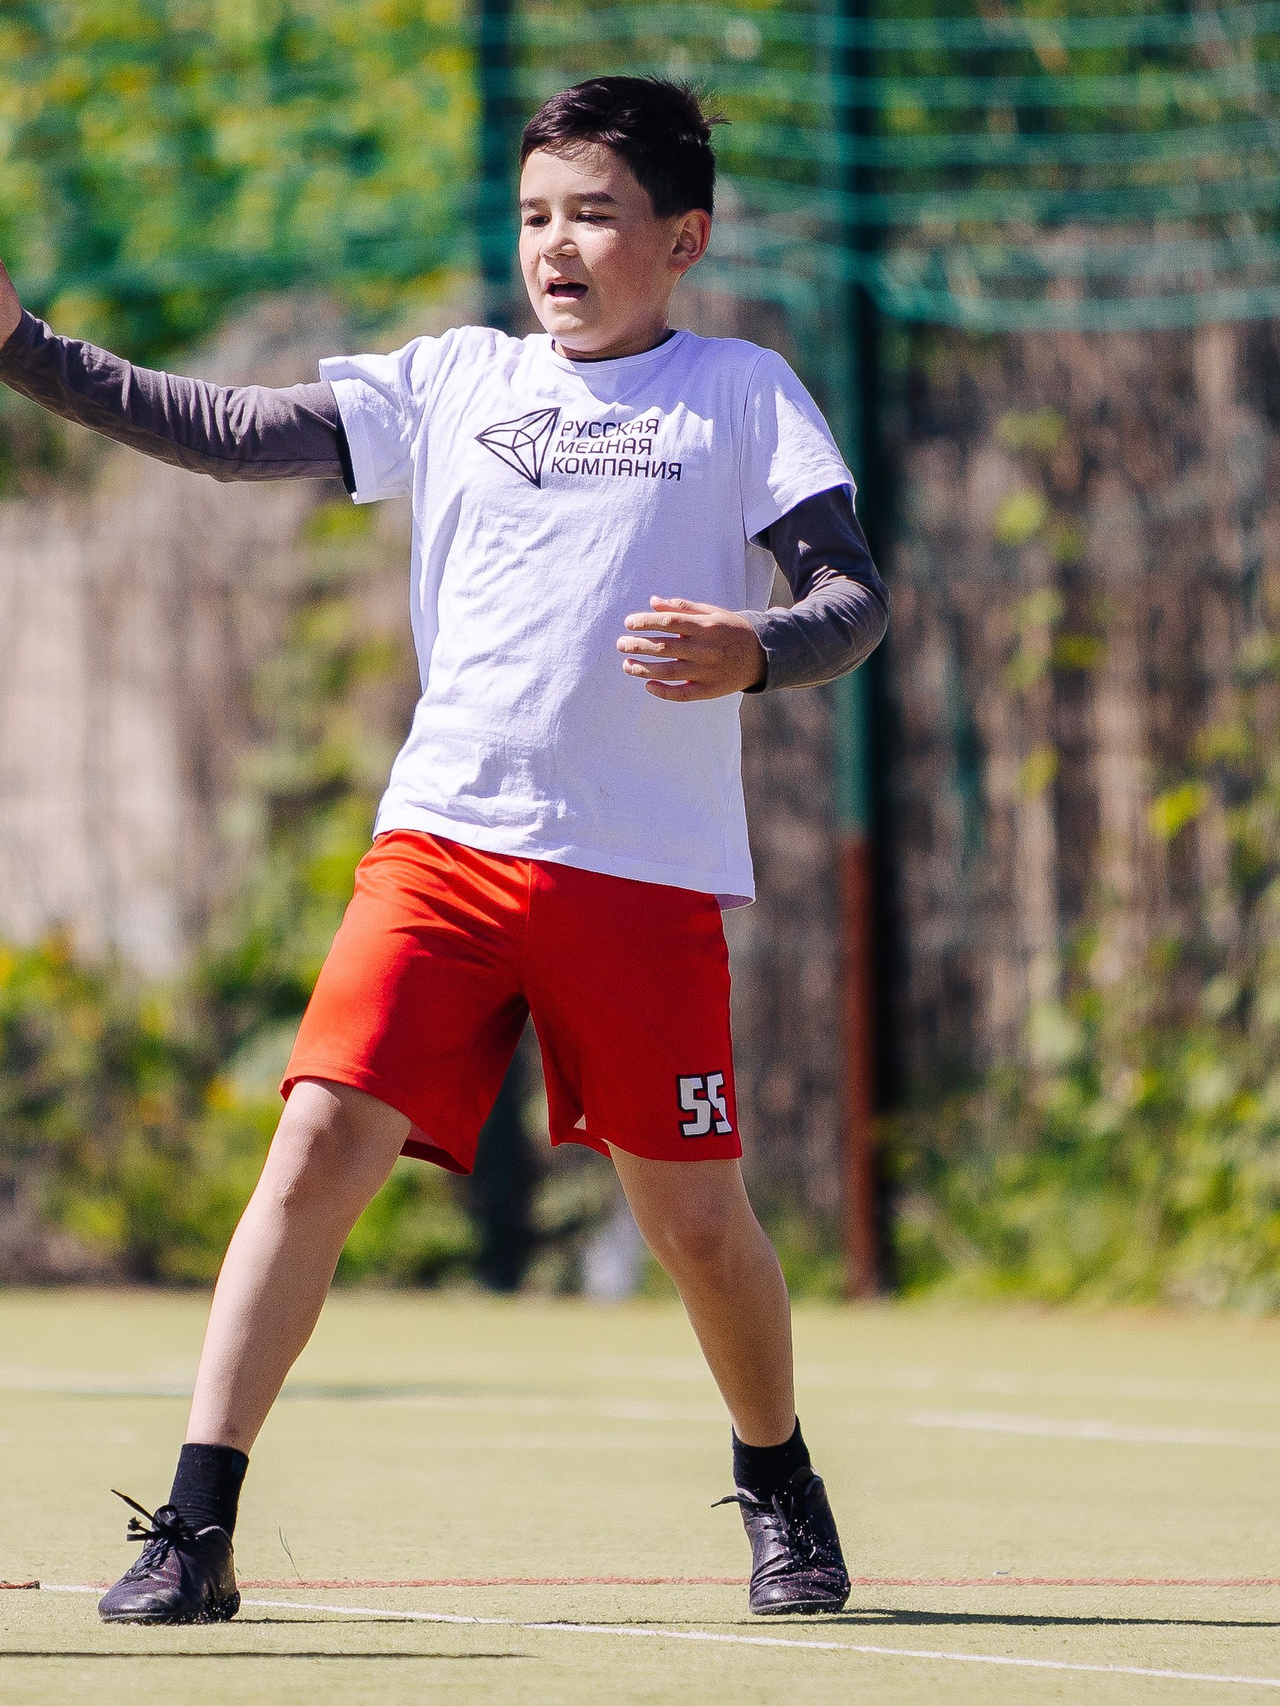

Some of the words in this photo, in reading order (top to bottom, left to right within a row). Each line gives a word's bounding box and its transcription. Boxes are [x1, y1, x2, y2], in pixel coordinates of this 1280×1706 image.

[560, 418, 659, 438] РУССКАЯ
[556, 438, 652, 455] МЕДНАЯ
[551, 457, 682, 481] КОМПАНИЯ
